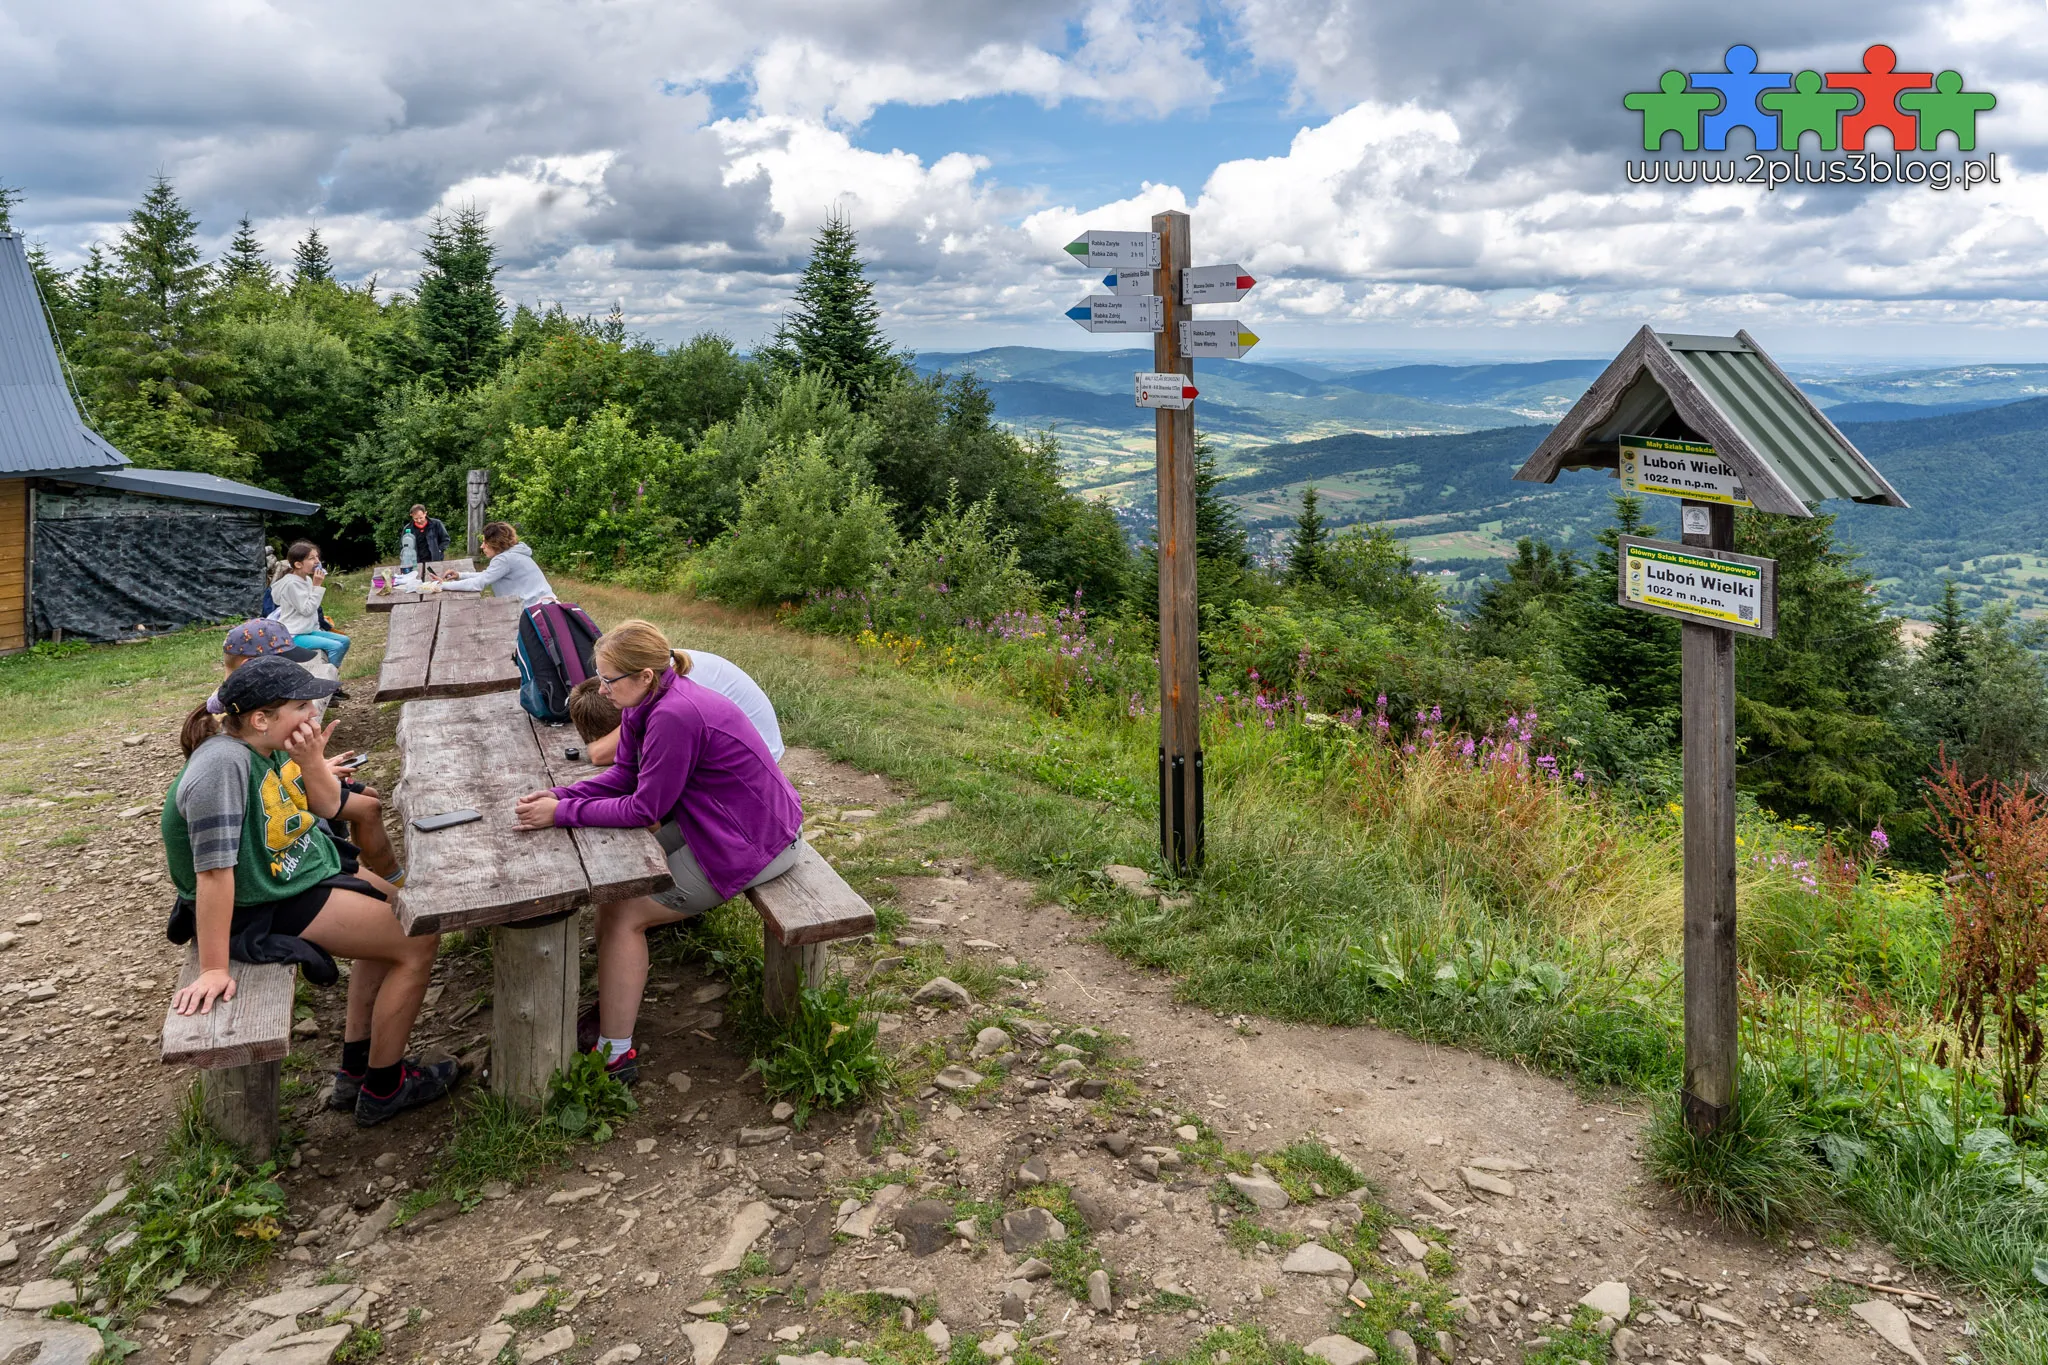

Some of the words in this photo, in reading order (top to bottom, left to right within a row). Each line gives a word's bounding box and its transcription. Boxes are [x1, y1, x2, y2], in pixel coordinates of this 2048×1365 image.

[1646, 441, 1662, 449] Mały
[1643, 455, 1686, 471] Luboń
[1644, 473, 1668, 483] 1022
[1672, 477, 1681, 485] m
[1685, 479, 1717, 490] n.p.m.
[1630, 548, 1656, 559] Główny
[1658, 552, 1676, 562] Szlak
[1679, 556, 1708, 567] Beskidu
[1710, 562, 1756, 576] Wyspowego
[1647, 566, 1695, 586] Luboń
[1701, 576, 1754, 598] Wielki
[1647, 584, 1672, 596] 1022
[1677, 591, 1686, 600] m
[1690, 594, 1724, 607] n.p.m.
